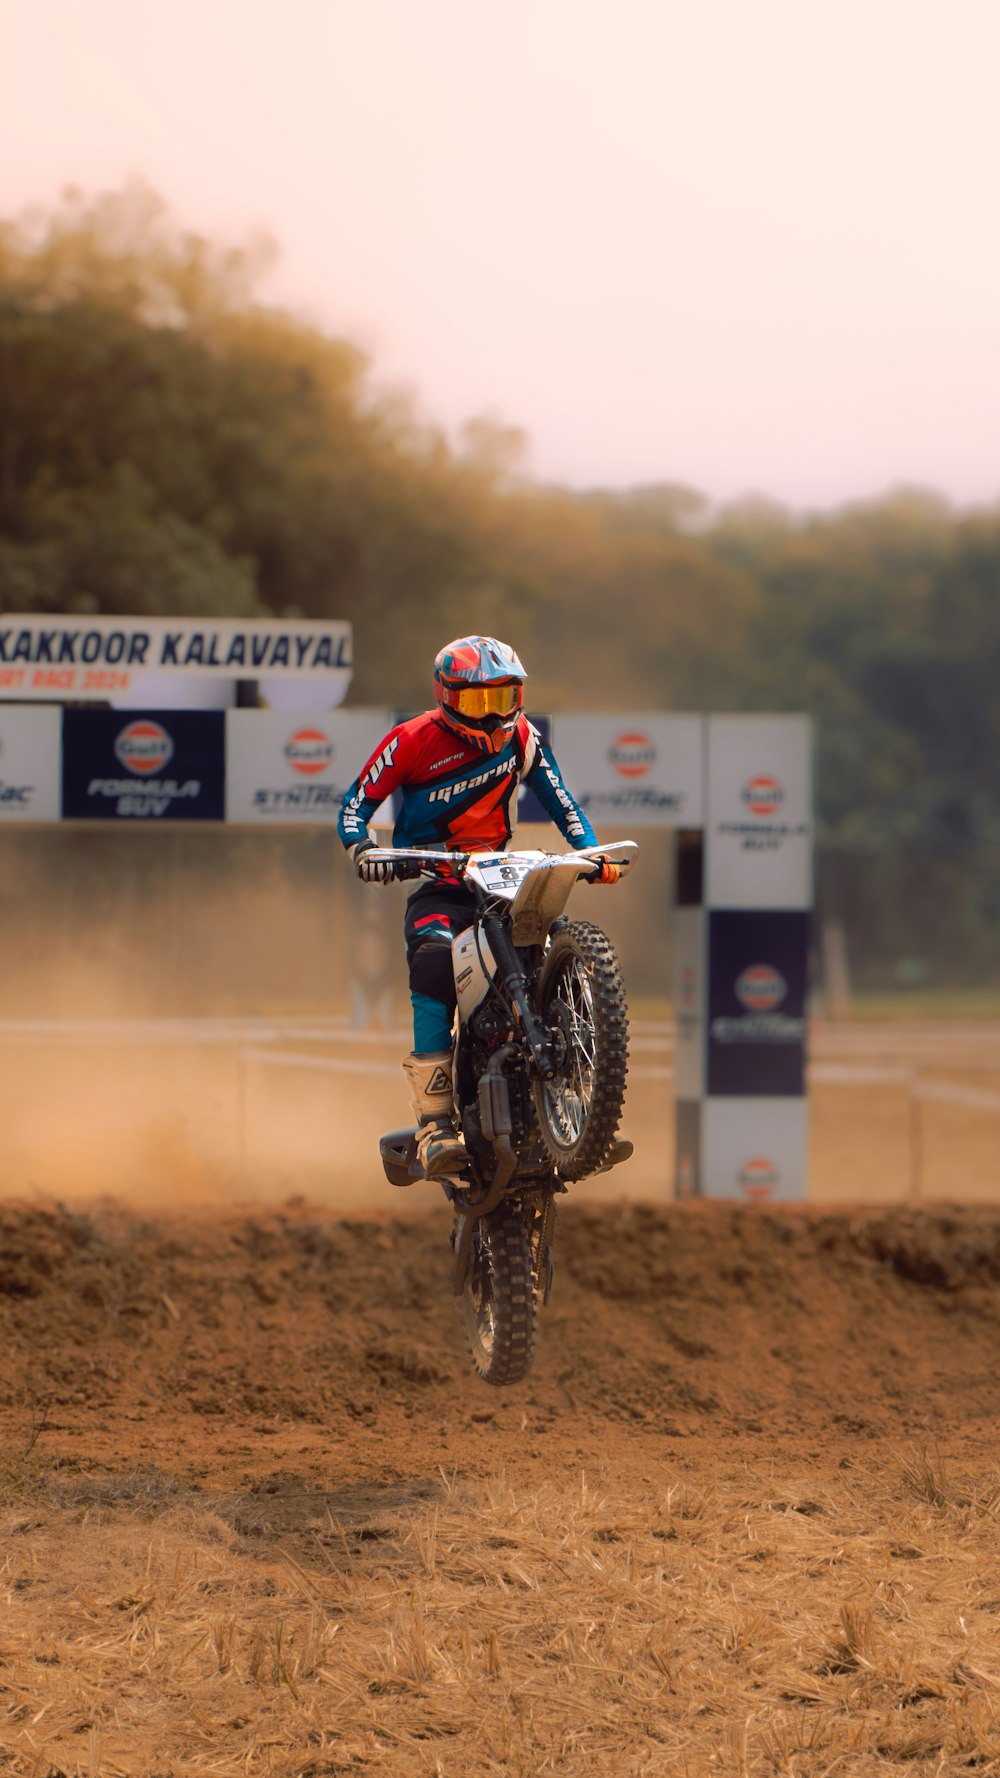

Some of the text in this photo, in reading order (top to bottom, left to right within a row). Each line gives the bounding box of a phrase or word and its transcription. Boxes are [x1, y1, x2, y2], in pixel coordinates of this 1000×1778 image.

[0, 629, 351, 669] KAKKOOR KALAVAYAL
[32, 668, 76, 690] RACE
[82, 670, 130, 690] 2024
[87, 778, 201, 798] FORMULA
